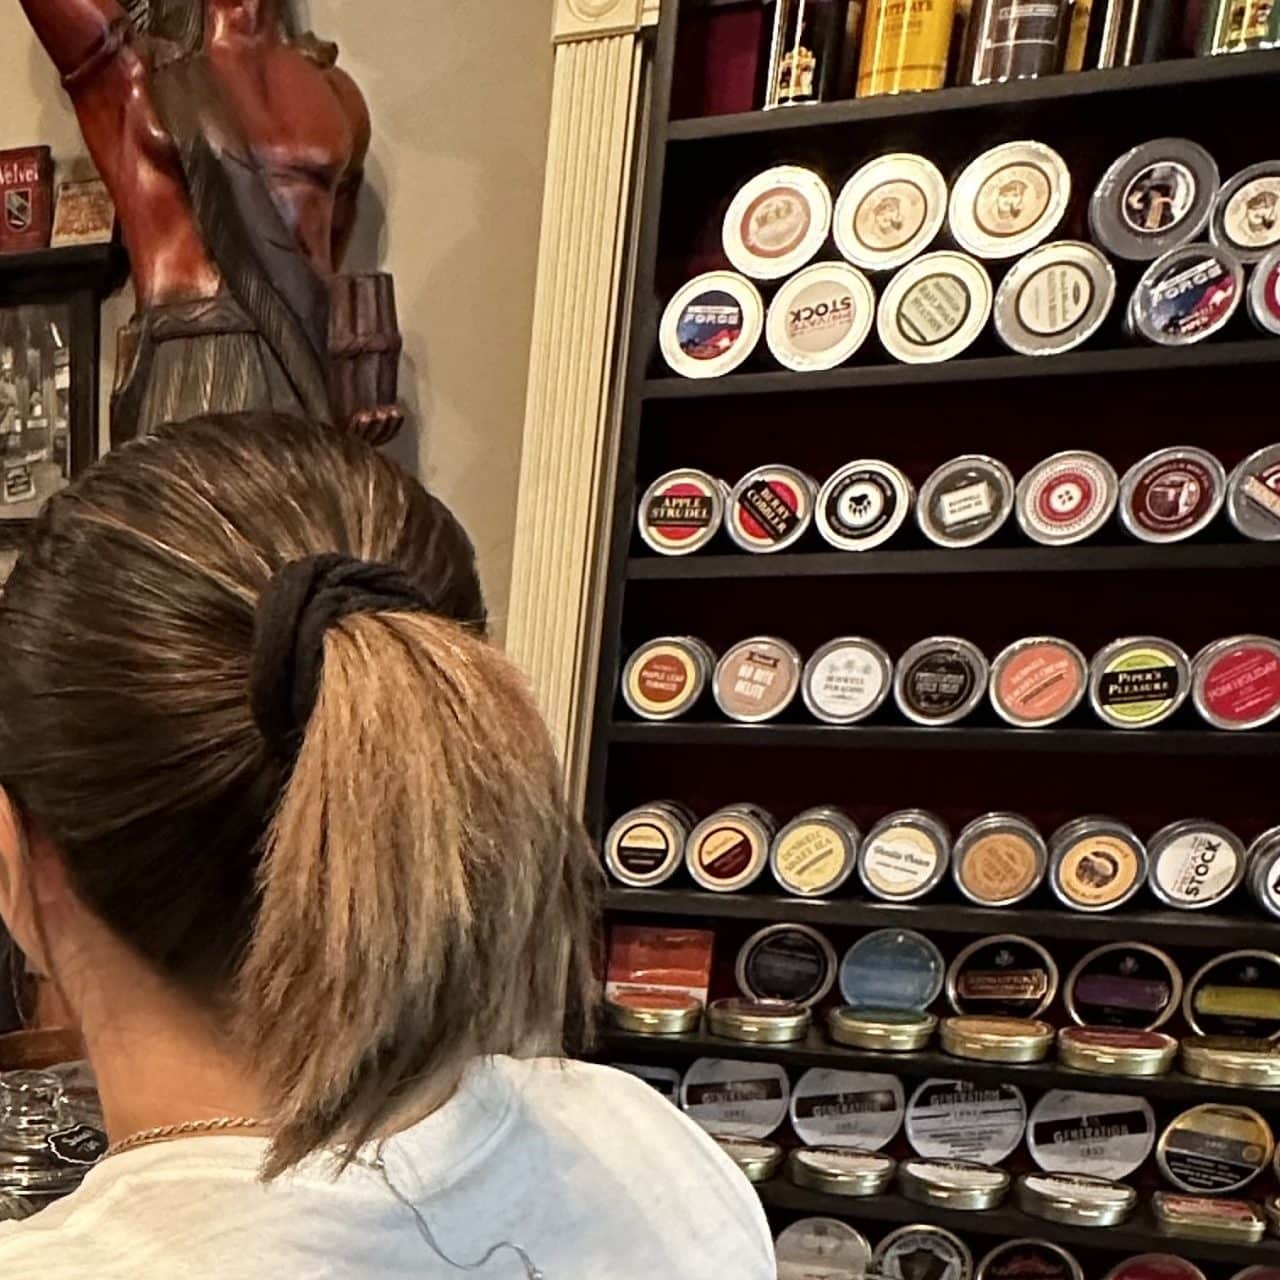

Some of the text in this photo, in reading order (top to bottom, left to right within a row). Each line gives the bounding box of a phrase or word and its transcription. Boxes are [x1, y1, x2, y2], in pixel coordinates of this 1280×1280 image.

[790, 296, 852, 324] STOCK
[663, 498, 702, 508] APPLE
[760, 487, 791, 520] BERRY
[651, 507, 709, 519] STRUDEL
[1118, 670, 1162, 684] PIPER'S
[1108, 681, 1169, 696] PLEASURE
[1185, 841, 1223, 898] STOCK
[1053, 1125, 1129, 1143] GENERATION
